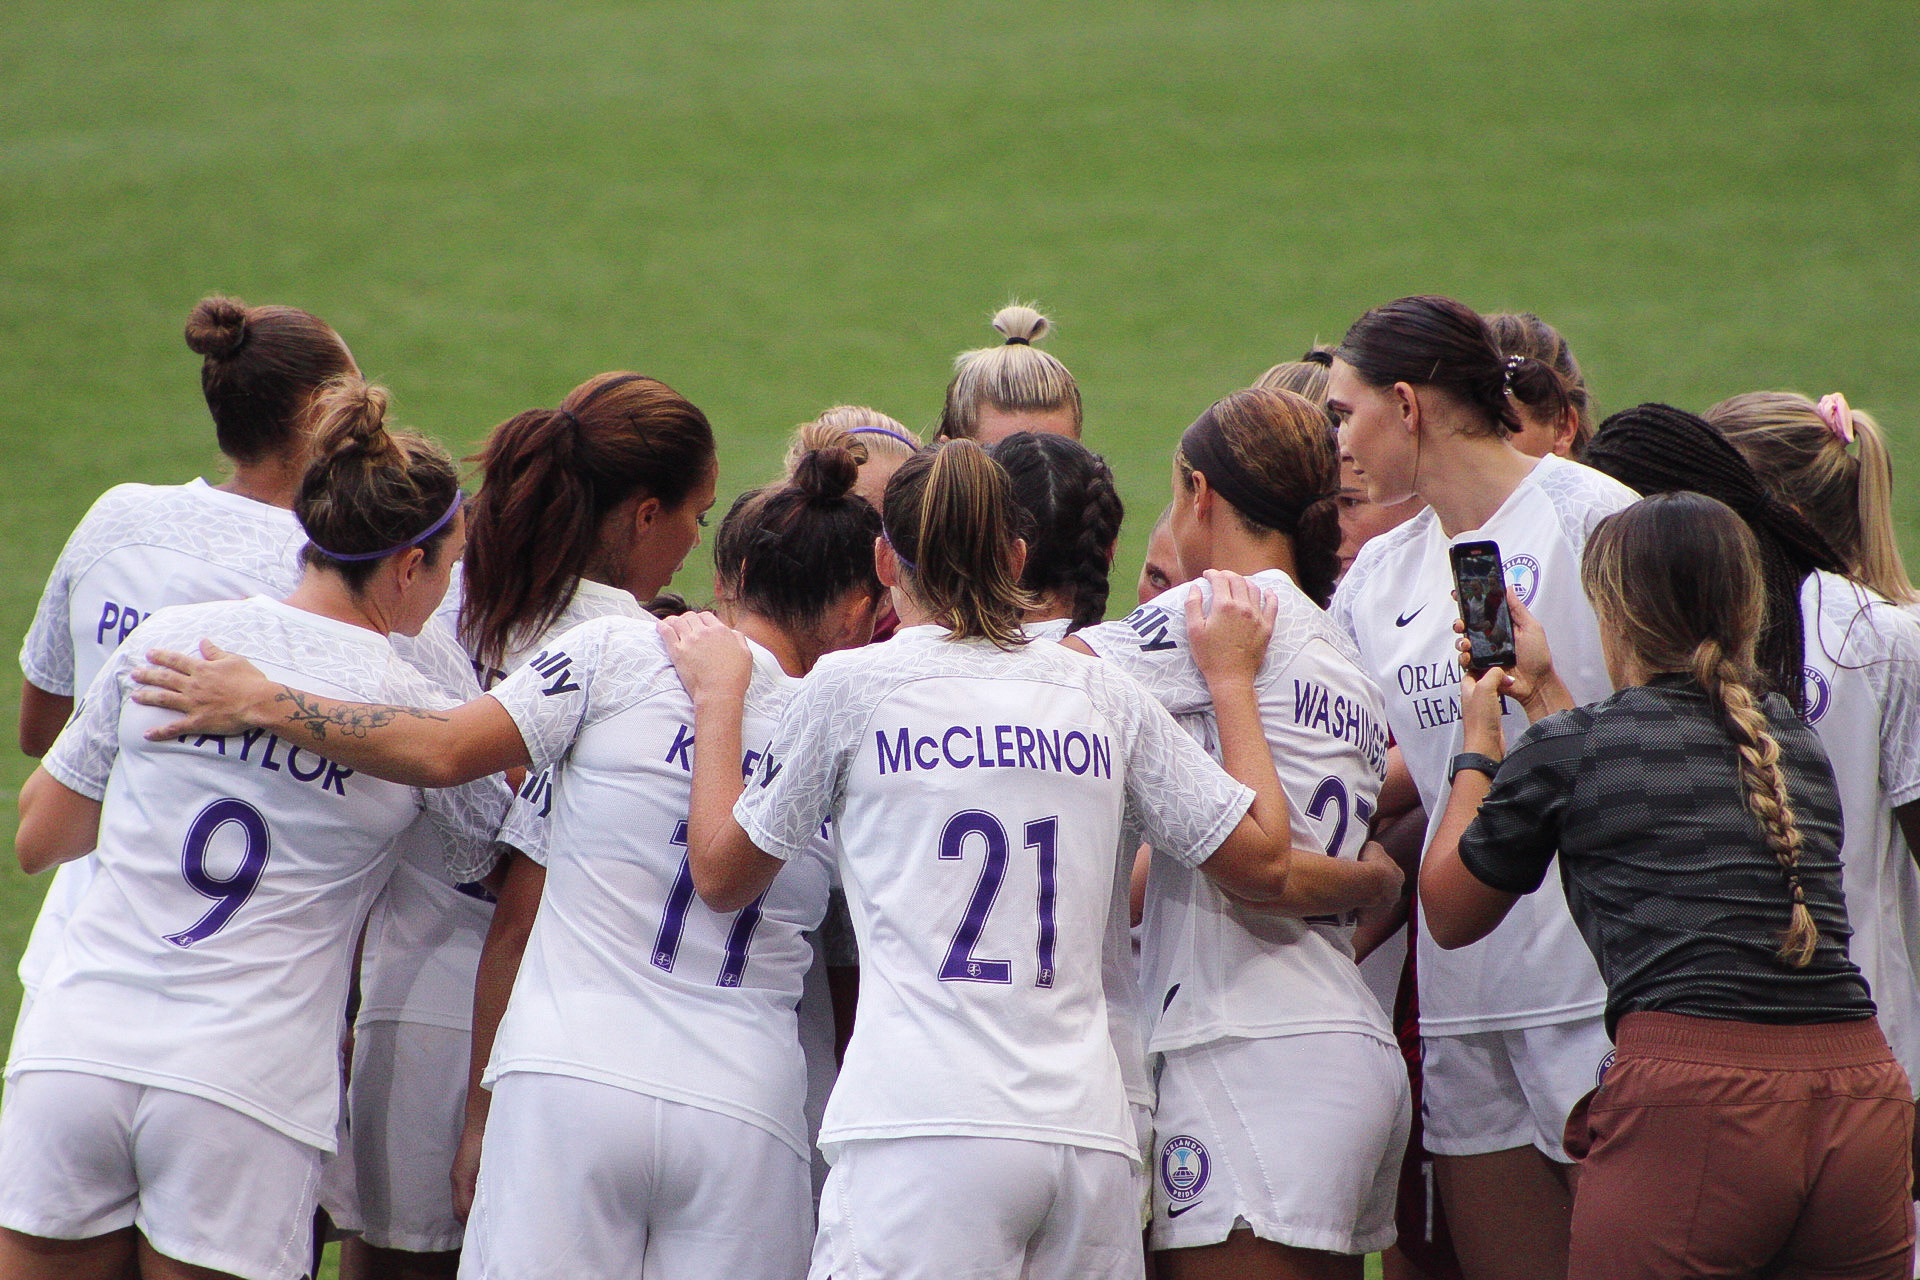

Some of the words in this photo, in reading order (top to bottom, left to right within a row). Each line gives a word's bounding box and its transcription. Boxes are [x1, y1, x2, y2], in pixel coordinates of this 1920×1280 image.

[97, 601, 152, 646] PR
[1398, 659, 1461, 695] ORLA
[876, 725, 1112, 780] McCLERNON
[161, 797, 271, 949] 9
[938, 808, 1059, 989] 21
[1165, 1140, 1203, 1156] ORLANDO
[1172, 1188, 1195, 1198] PRIDE
